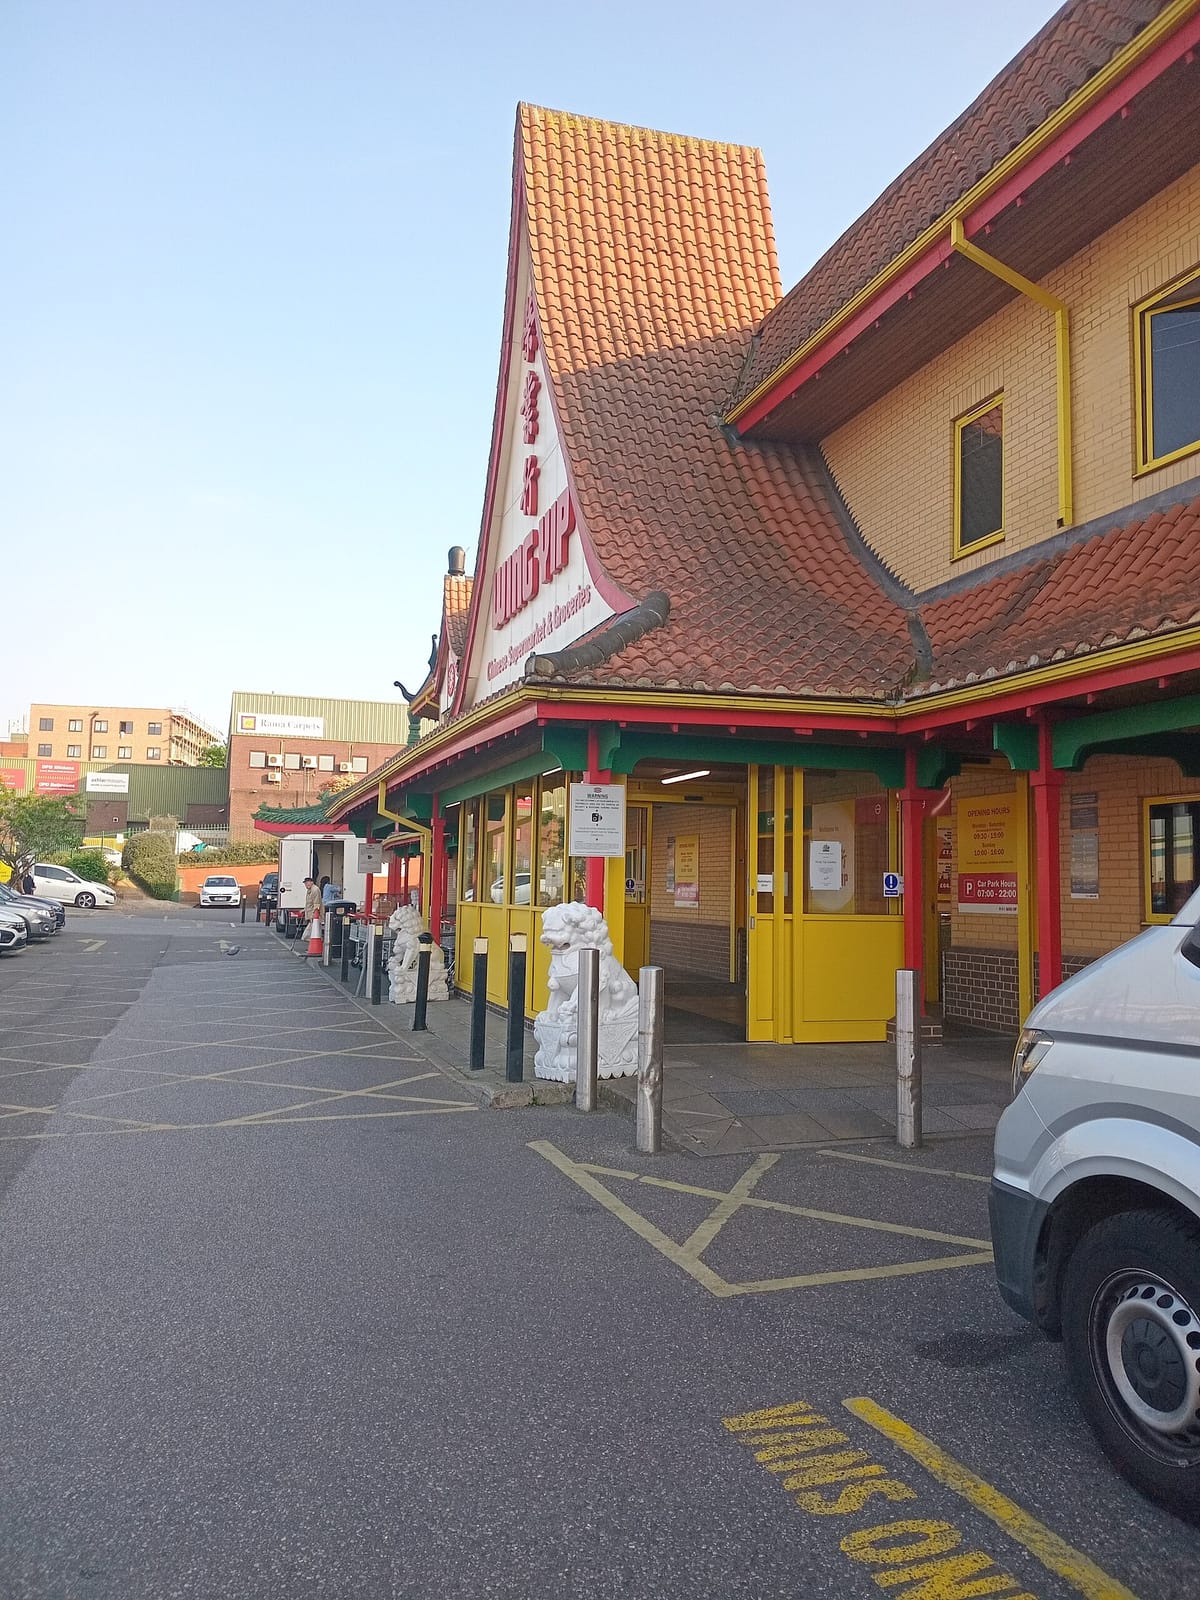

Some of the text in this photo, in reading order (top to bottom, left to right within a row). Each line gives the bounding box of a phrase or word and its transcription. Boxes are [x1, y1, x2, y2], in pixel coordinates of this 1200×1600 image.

[492, 486, 576, 630] WING YIP
[487, 584, 592, 681] Chinese Supermarket & Groceries
[967, 809, 990, 818] OPENING
[977, 889, 994, 897] 07:00
[998, 889, 1016, 897] 22:00
[839, 1518, 1040, 1600] ON
